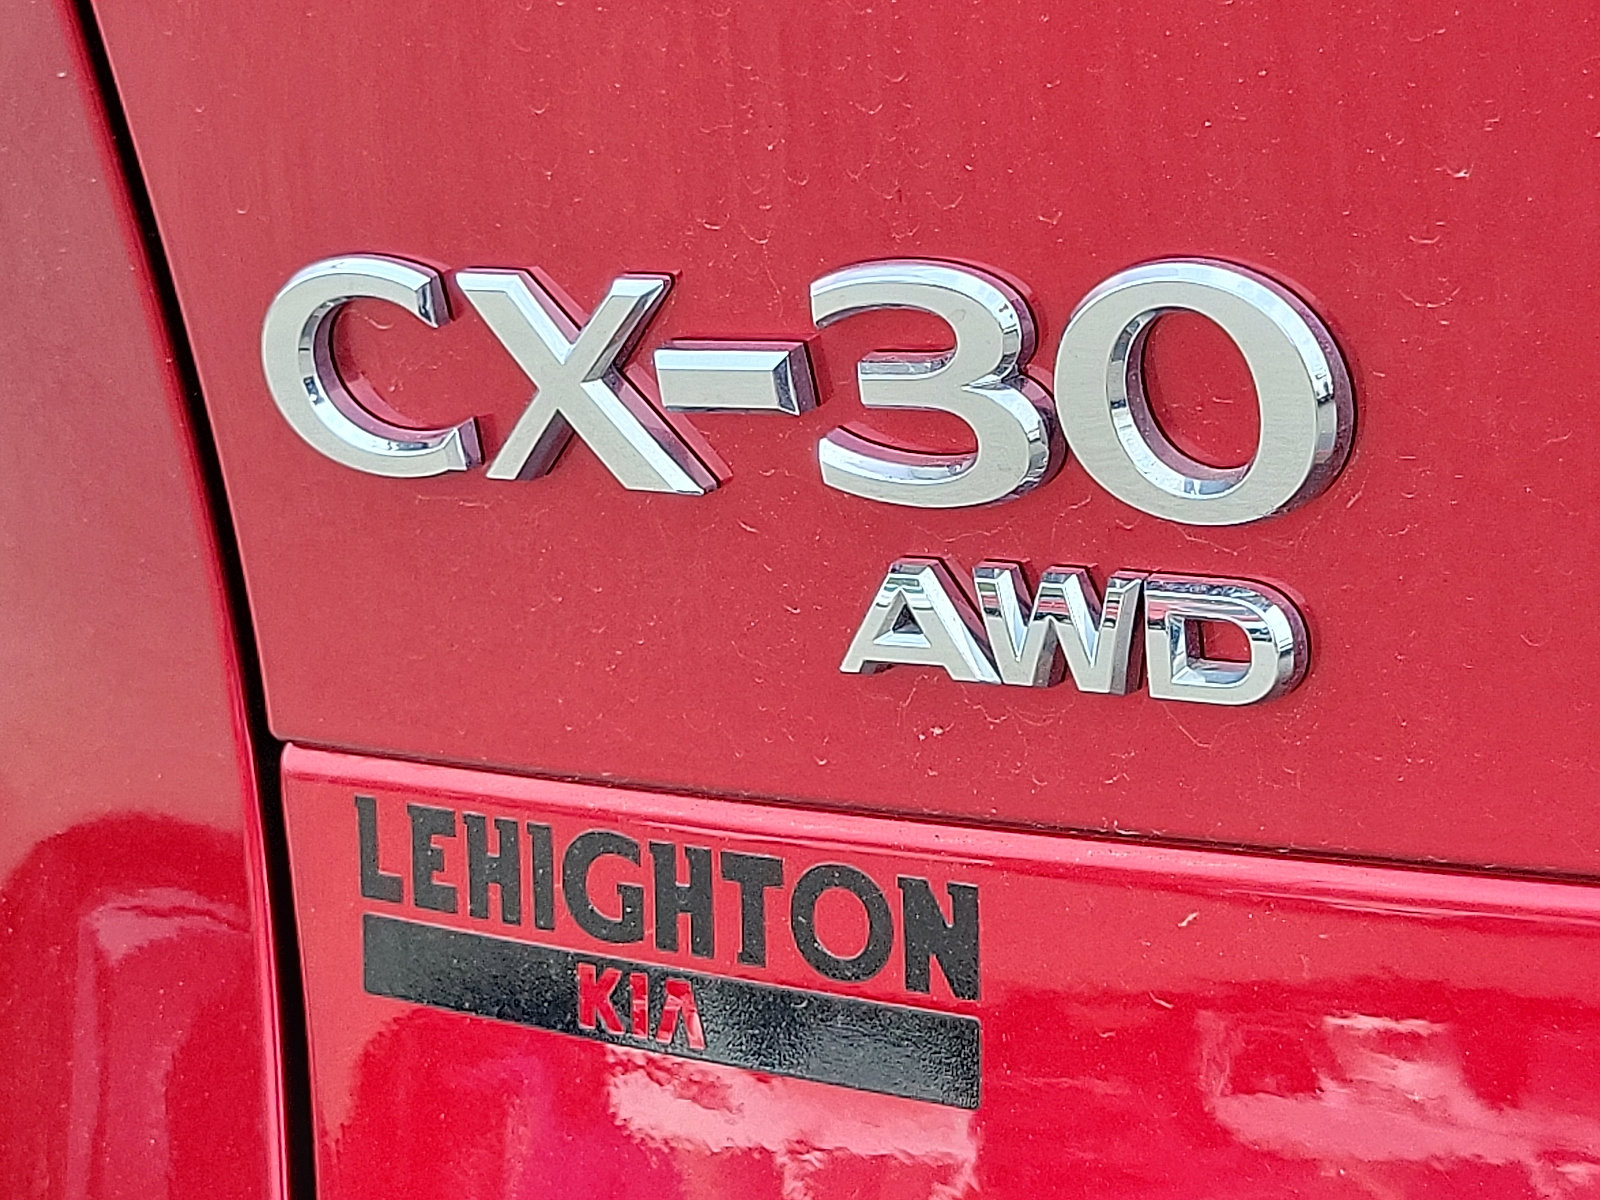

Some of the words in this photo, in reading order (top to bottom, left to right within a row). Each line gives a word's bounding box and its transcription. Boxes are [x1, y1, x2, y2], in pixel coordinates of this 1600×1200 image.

[262, 253, 1355, 526] CX-30
[840, 557, 1309, 706] AWD
[355, 796, 980, 1002] LEHIGHTON
[577, 963, 706, 1050] KIA
